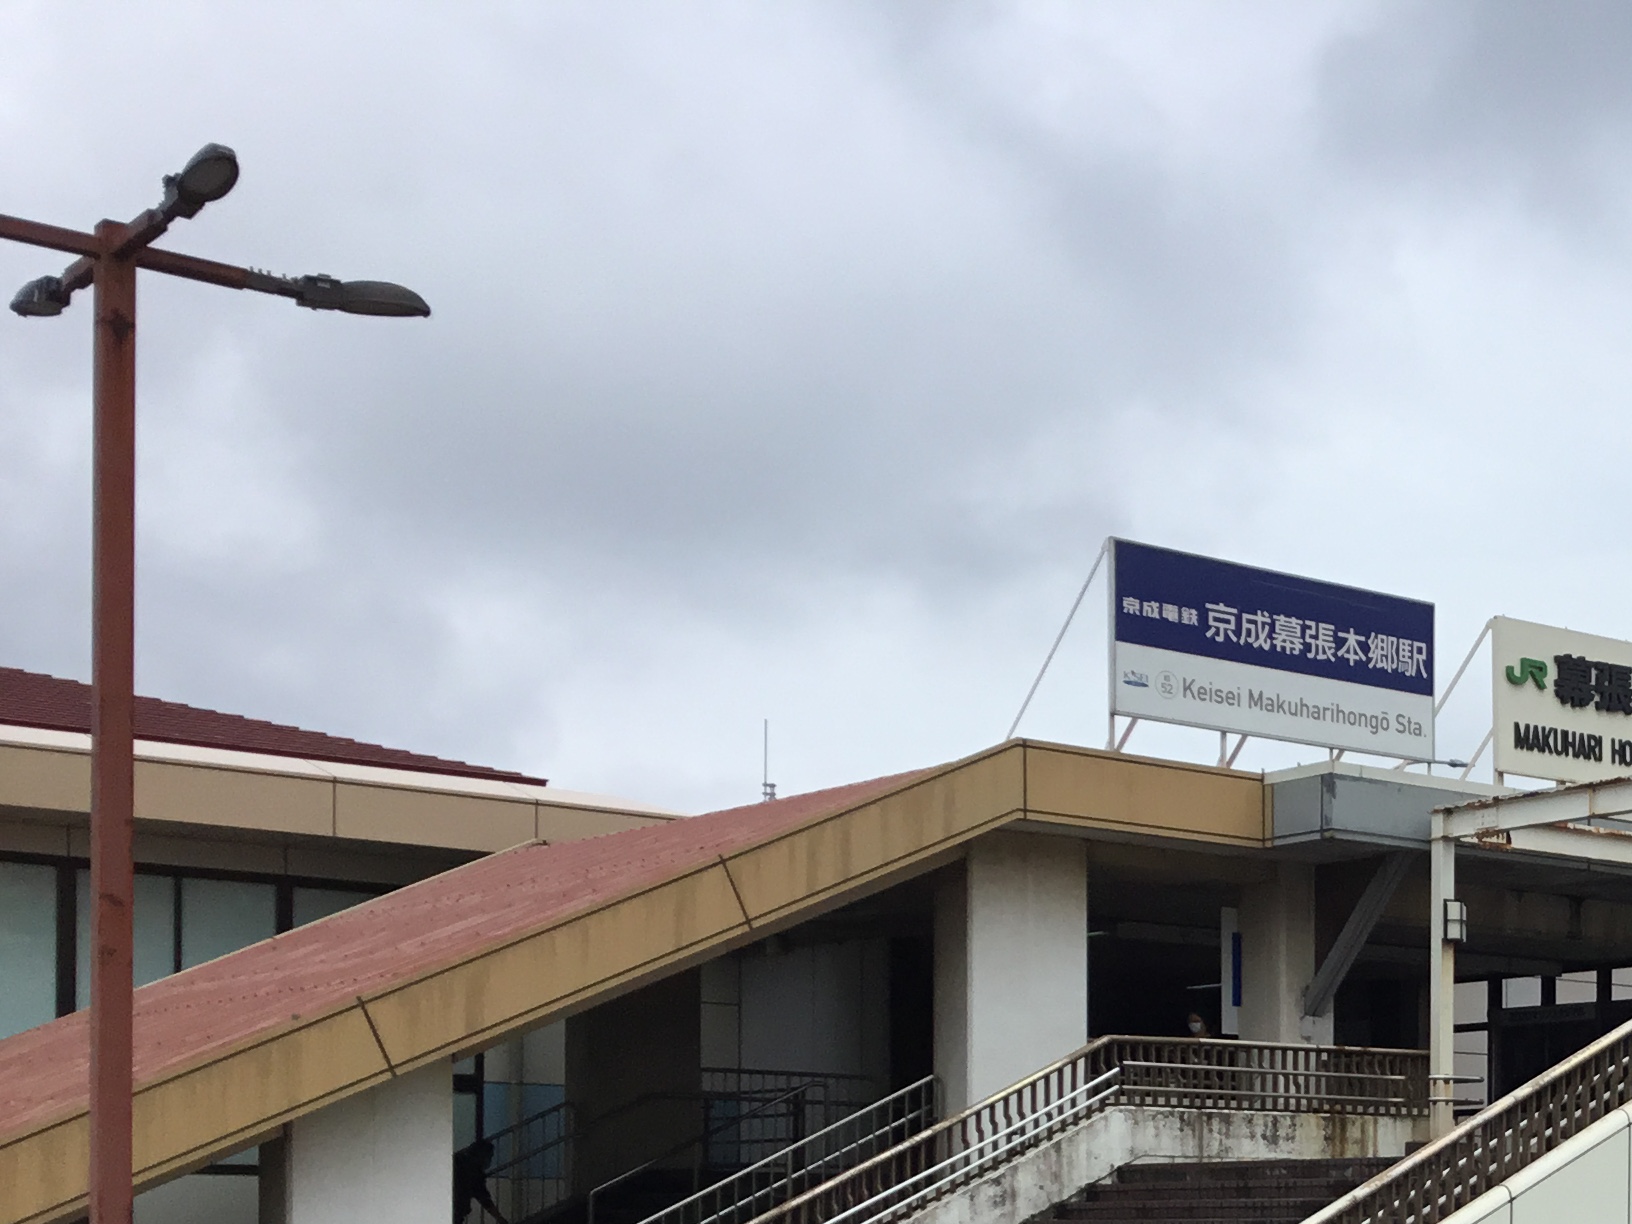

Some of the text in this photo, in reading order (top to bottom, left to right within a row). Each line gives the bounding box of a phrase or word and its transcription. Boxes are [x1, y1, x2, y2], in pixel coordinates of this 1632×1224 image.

[1122, 597, 1428, 679] 京成電鉄 京成幕張本郷駅
[1506, 657, 1548, 690] JR
[1182, 677, 1427, 738] Keisei Makuharihongō Sta.
[1514, 721, 1603, 762] MAKUHARI
